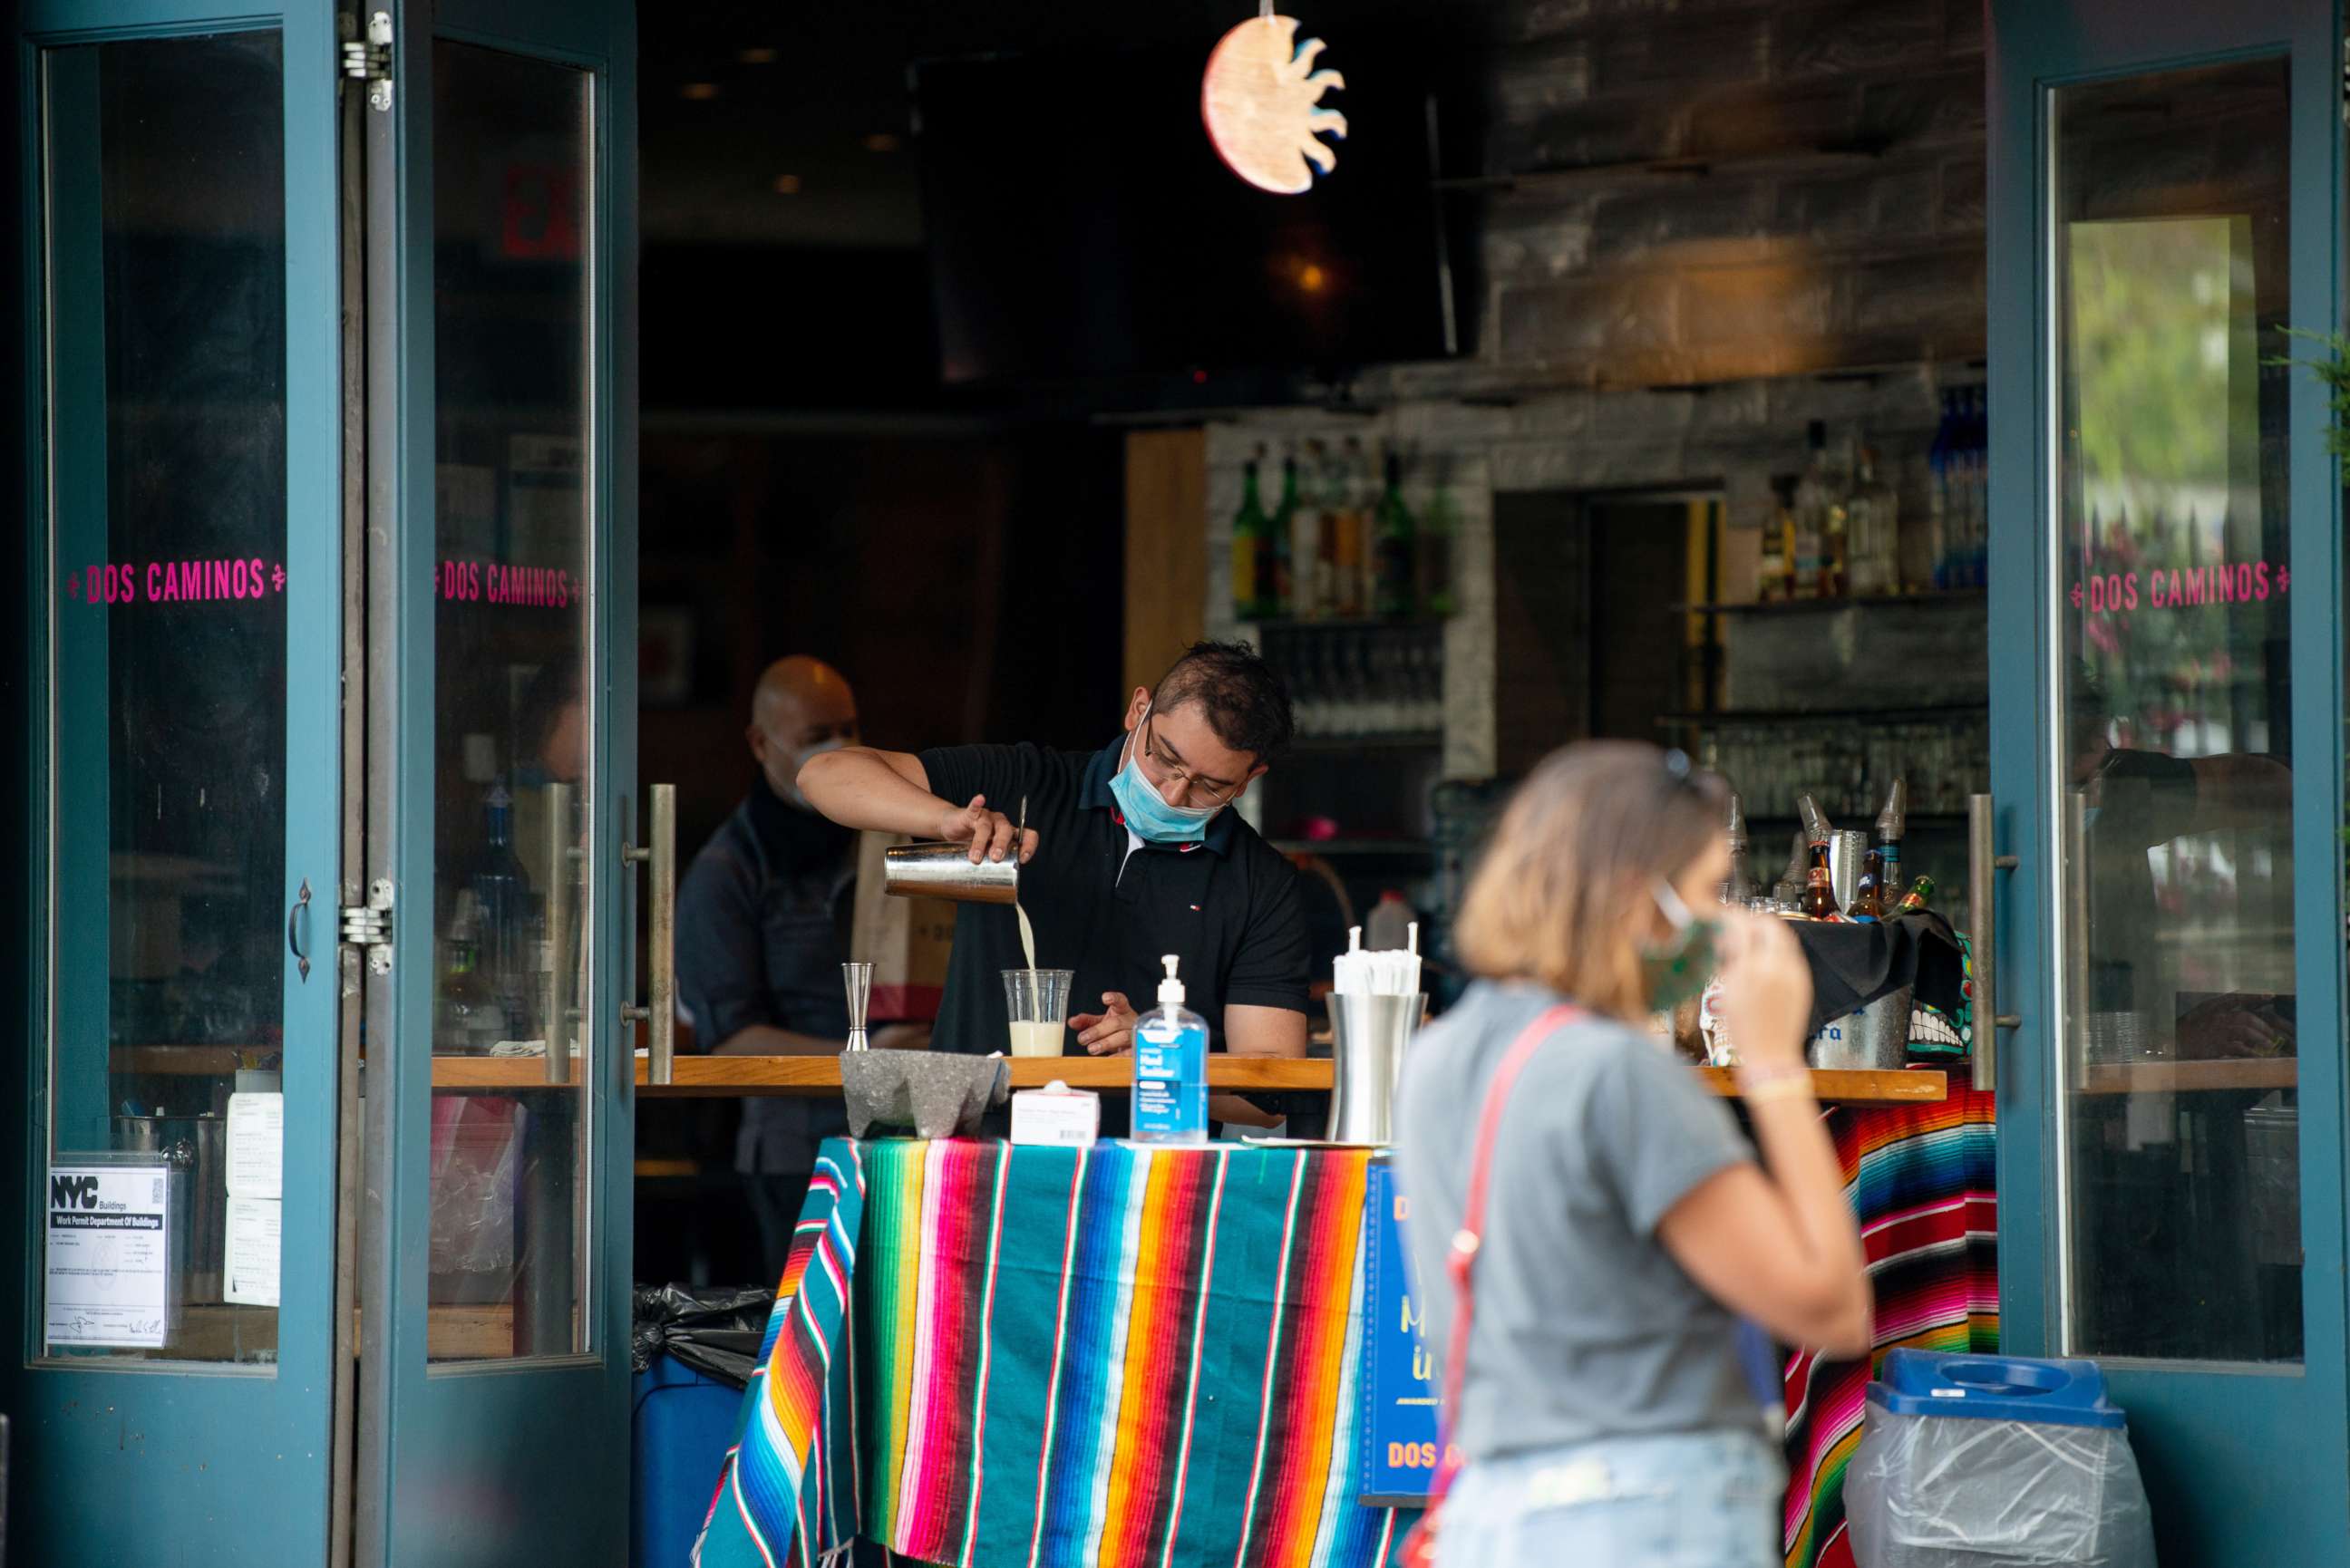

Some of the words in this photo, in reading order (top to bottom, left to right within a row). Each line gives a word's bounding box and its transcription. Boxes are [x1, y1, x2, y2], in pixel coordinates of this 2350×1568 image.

[87, 564, 134, 605] DOS
[147, 558, 265, 602] CAMINOS
[444, 560, 479, 601] DOS
[487, 564, 567, 608] CAMINOS
[2090, 573, 2138, 613] DOS
[2151, 560, 2269, 608] CAMINOS
[51, 1176, 98, 1208] NYC
[99, 1201, 126, 1211] Buildings
[56, 1215, 71, 1225] Work
[72, 1216, 89, 1225] Permit
[90, 1216, 123, 1228] Department
[132, 1217, 159, 1228] Buildings
[1388, 1442, 1436, 1467] DOS
